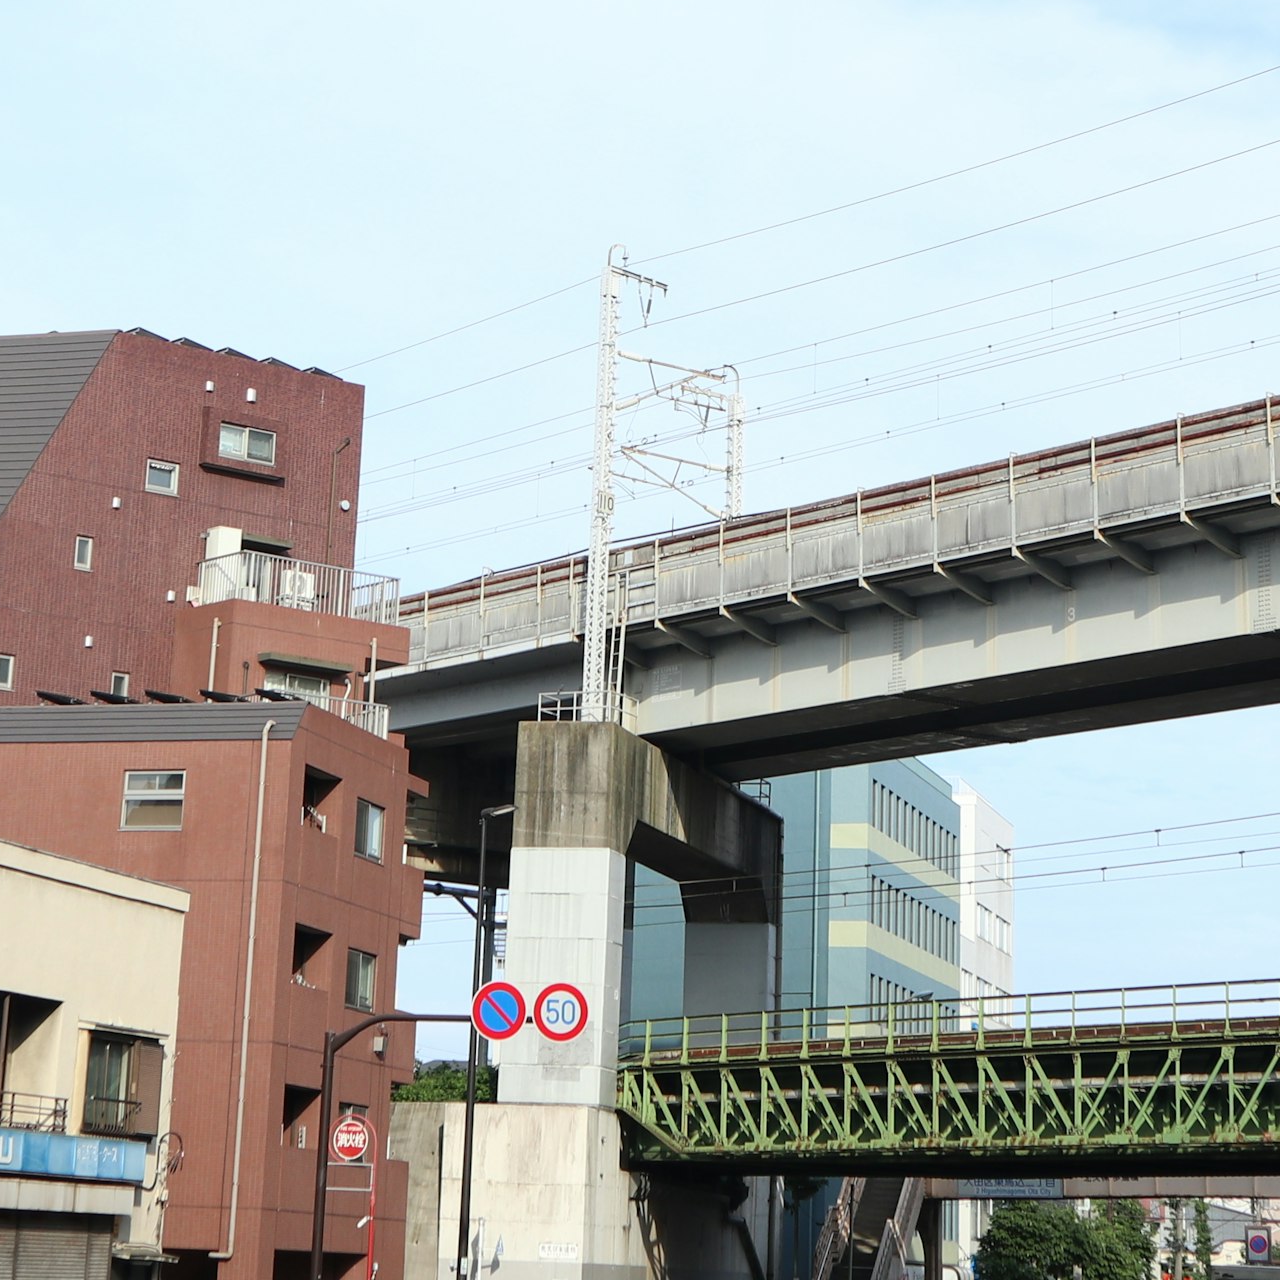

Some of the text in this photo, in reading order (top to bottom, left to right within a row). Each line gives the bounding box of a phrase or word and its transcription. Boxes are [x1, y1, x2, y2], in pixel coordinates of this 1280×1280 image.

[546, 999, 576, 1025] 50
[337, 1131, 365, 1148] 消火栓
